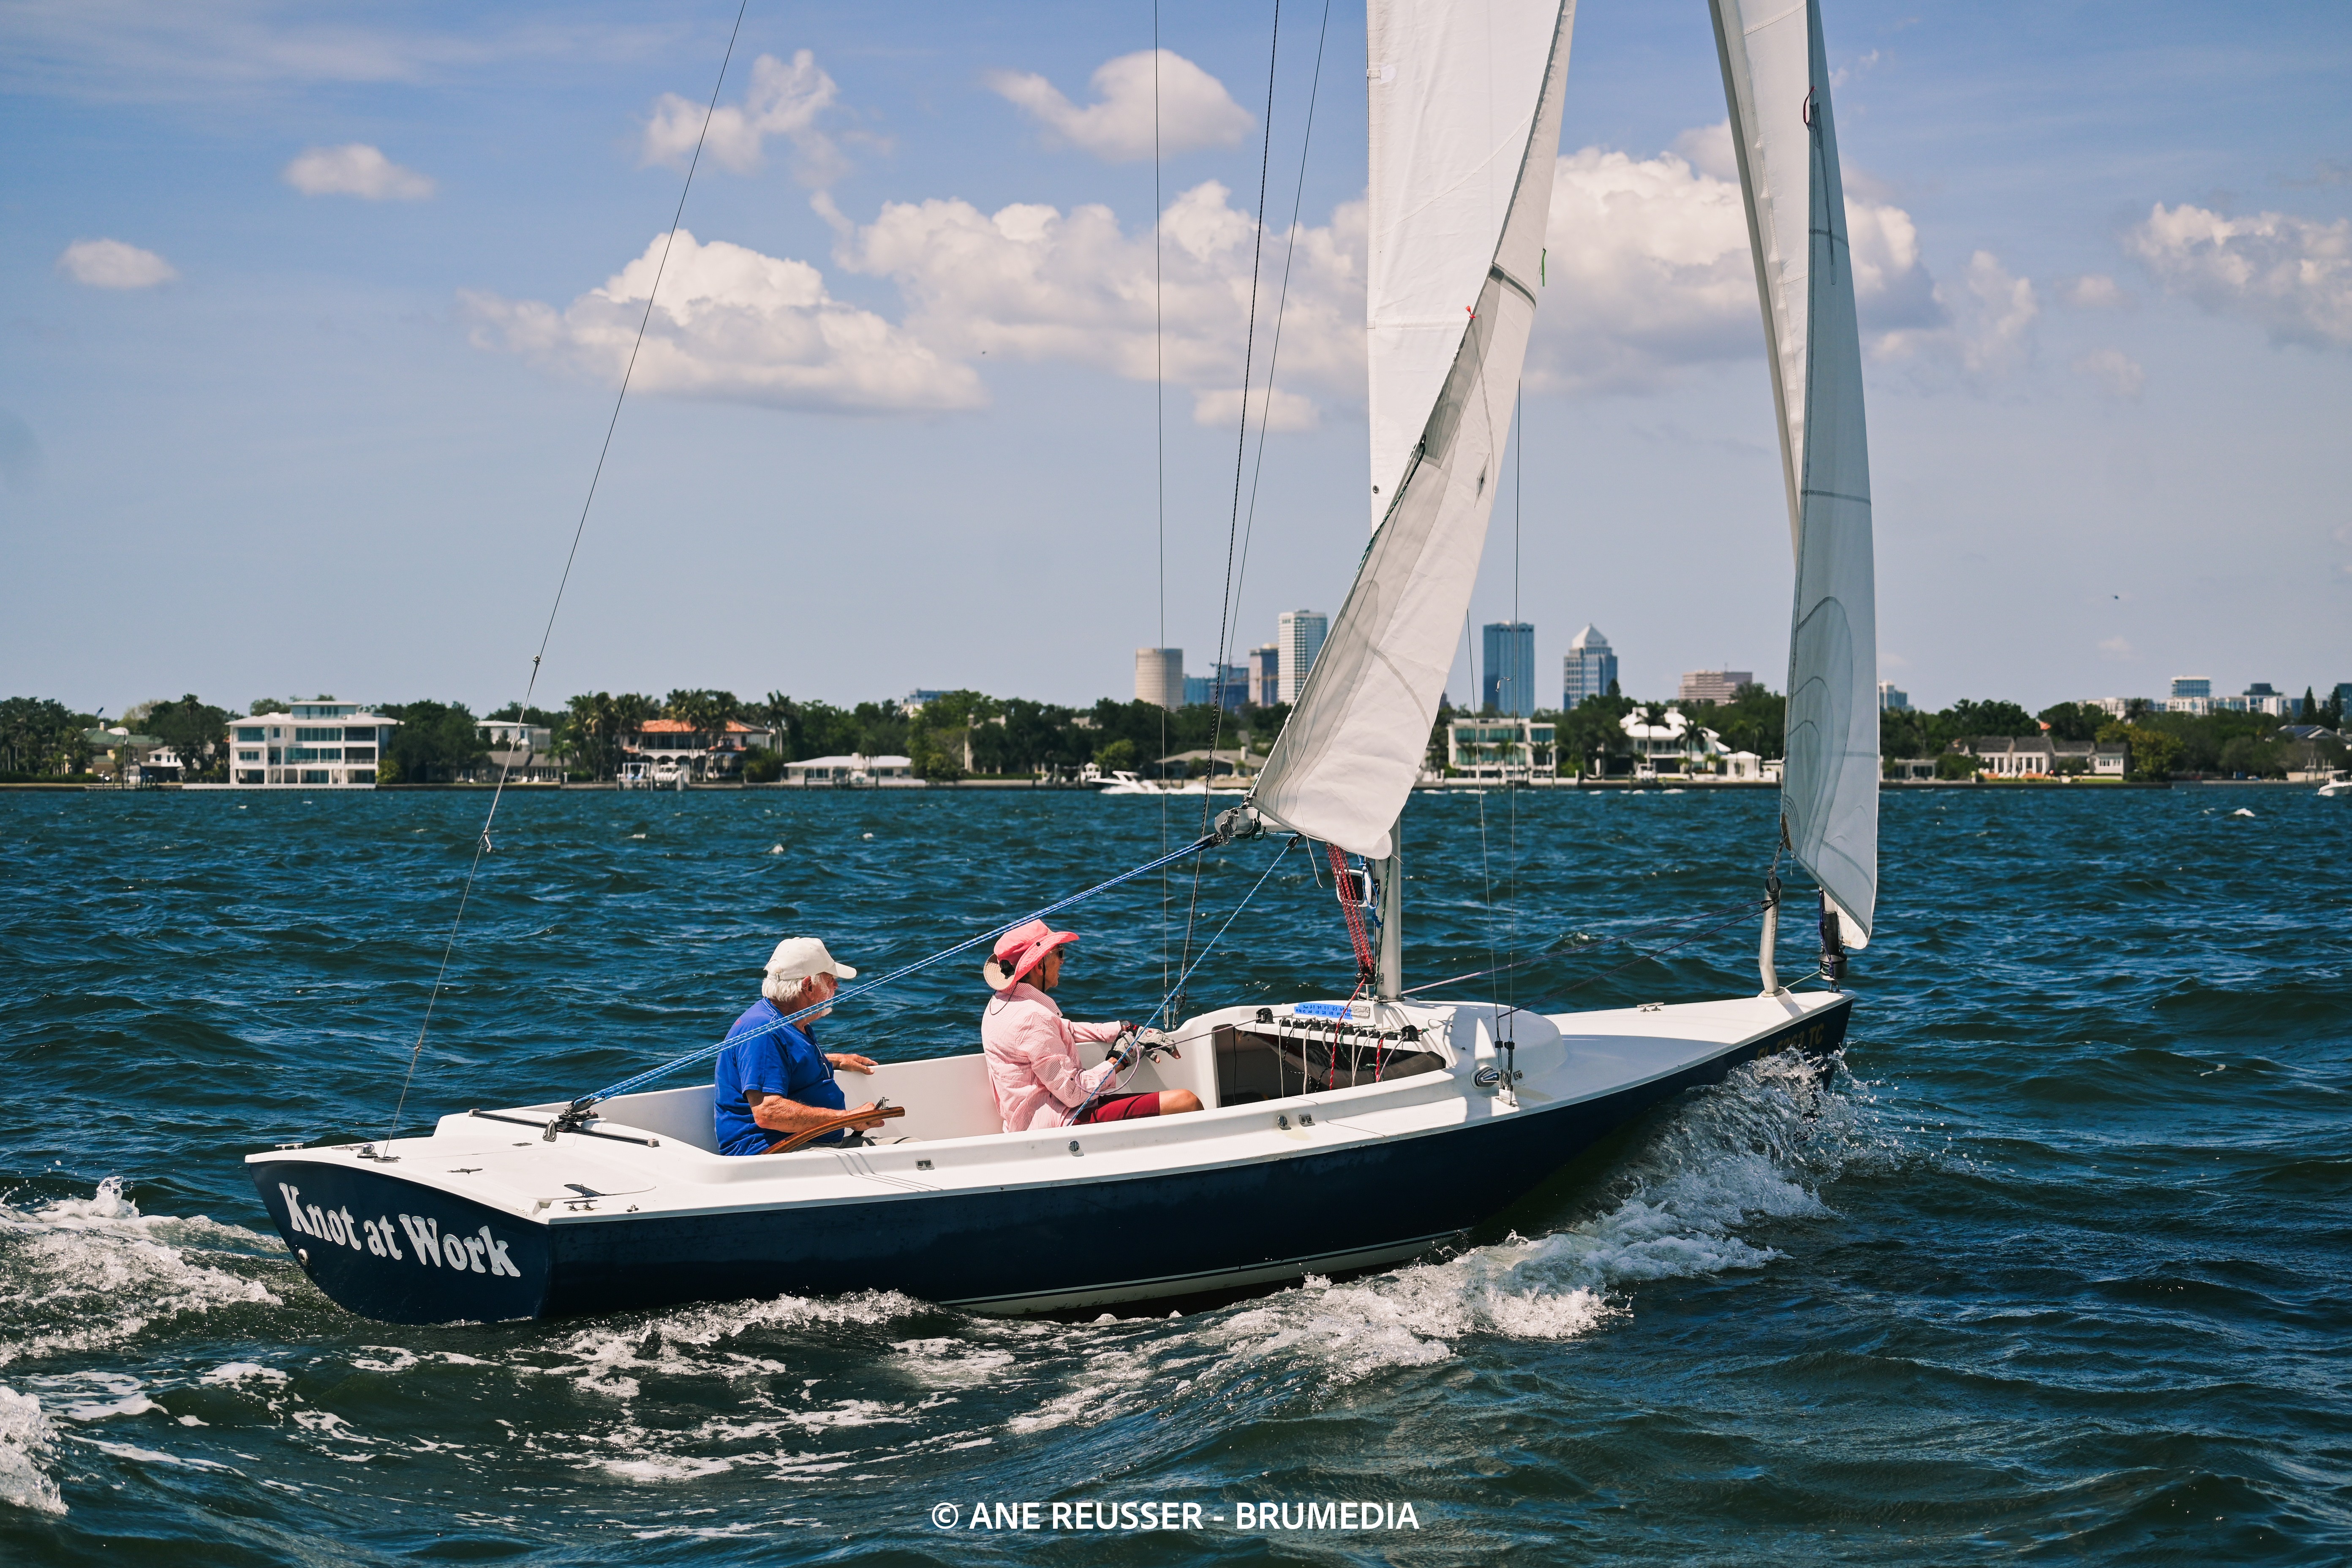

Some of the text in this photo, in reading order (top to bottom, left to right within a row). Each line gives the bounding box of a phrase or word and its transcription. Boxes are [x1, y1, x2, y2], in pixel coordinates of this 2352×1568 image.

[1809, 1023, 1824, 1048] TC
[279, 1182, 520, 1277] Knot at Work
